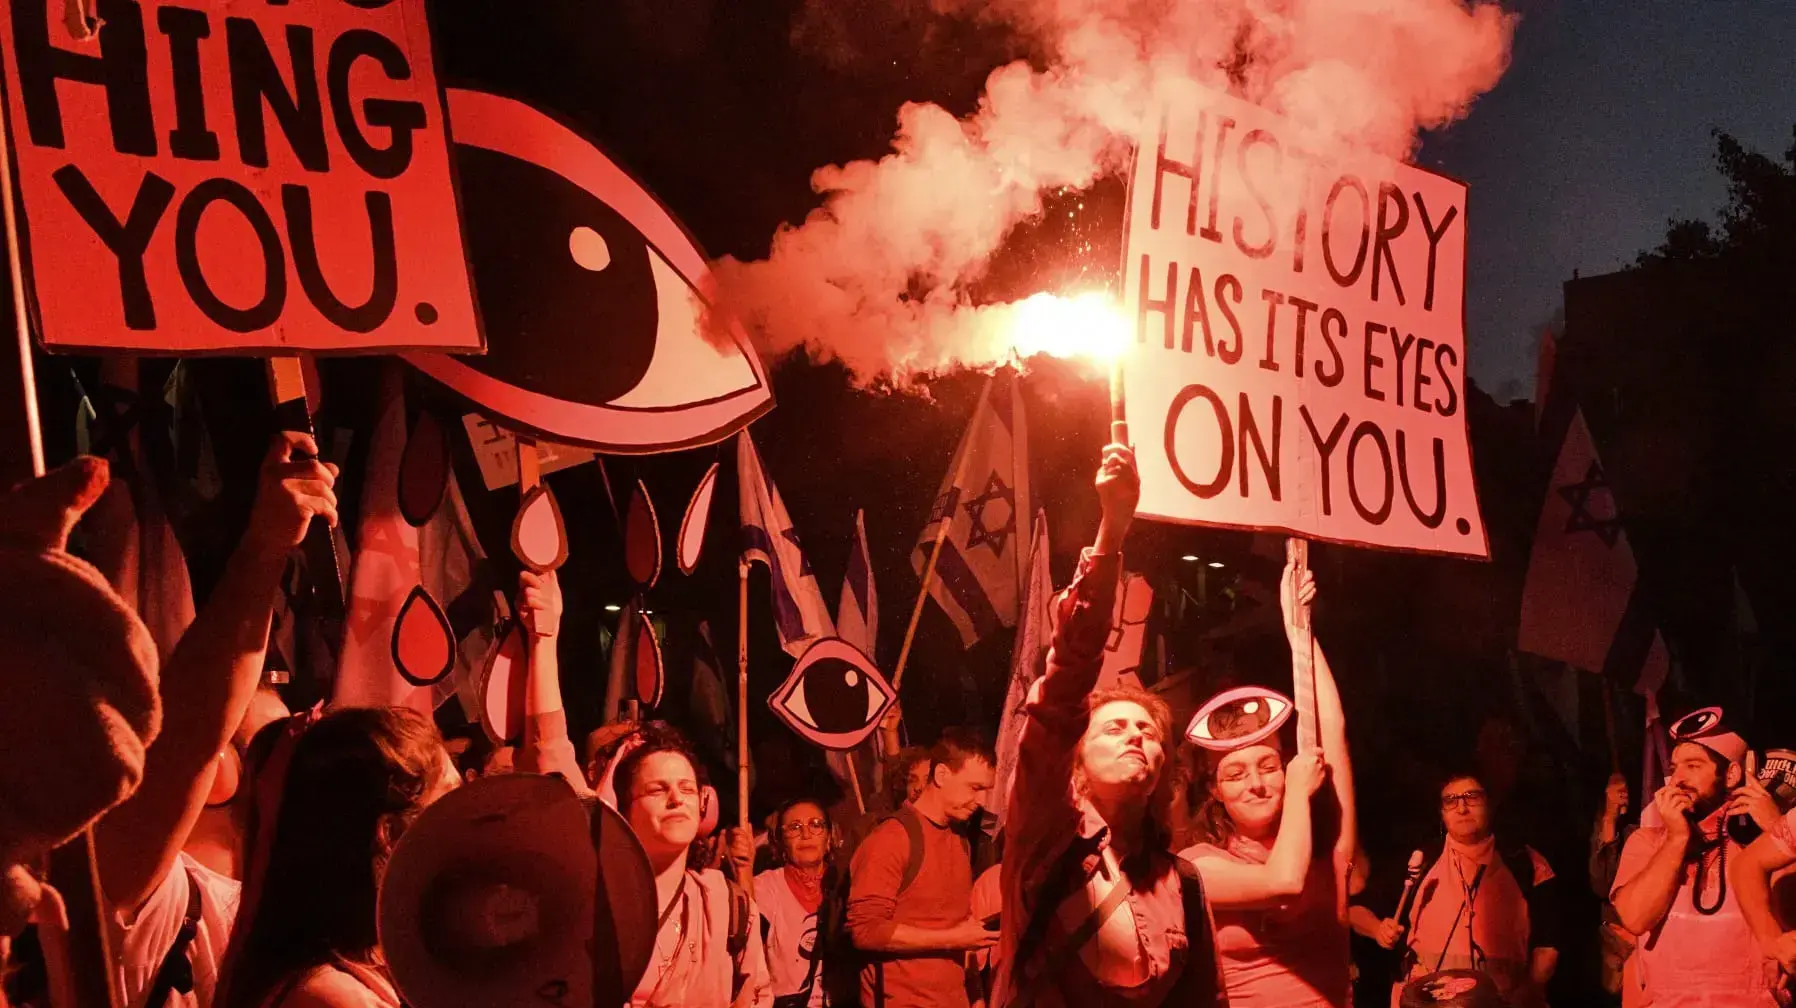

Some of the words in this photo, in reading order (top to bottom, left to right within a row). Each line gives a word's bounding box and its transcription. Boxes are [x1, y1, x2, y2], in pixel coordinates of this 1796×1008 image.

[9, 0, 427, 179] HING
[52, 164, 438, 333] YOU.
[1151, 103, 1458, 311] HISTORY
[1137, 254, 1243, 365] HAS
[1259, 289, 1348, 387] ITS
[1364, 321, 1458, 417] EYES
[1164, 384, 1282, 501] ON
[1299, 404, 1471, 535] YOU.
